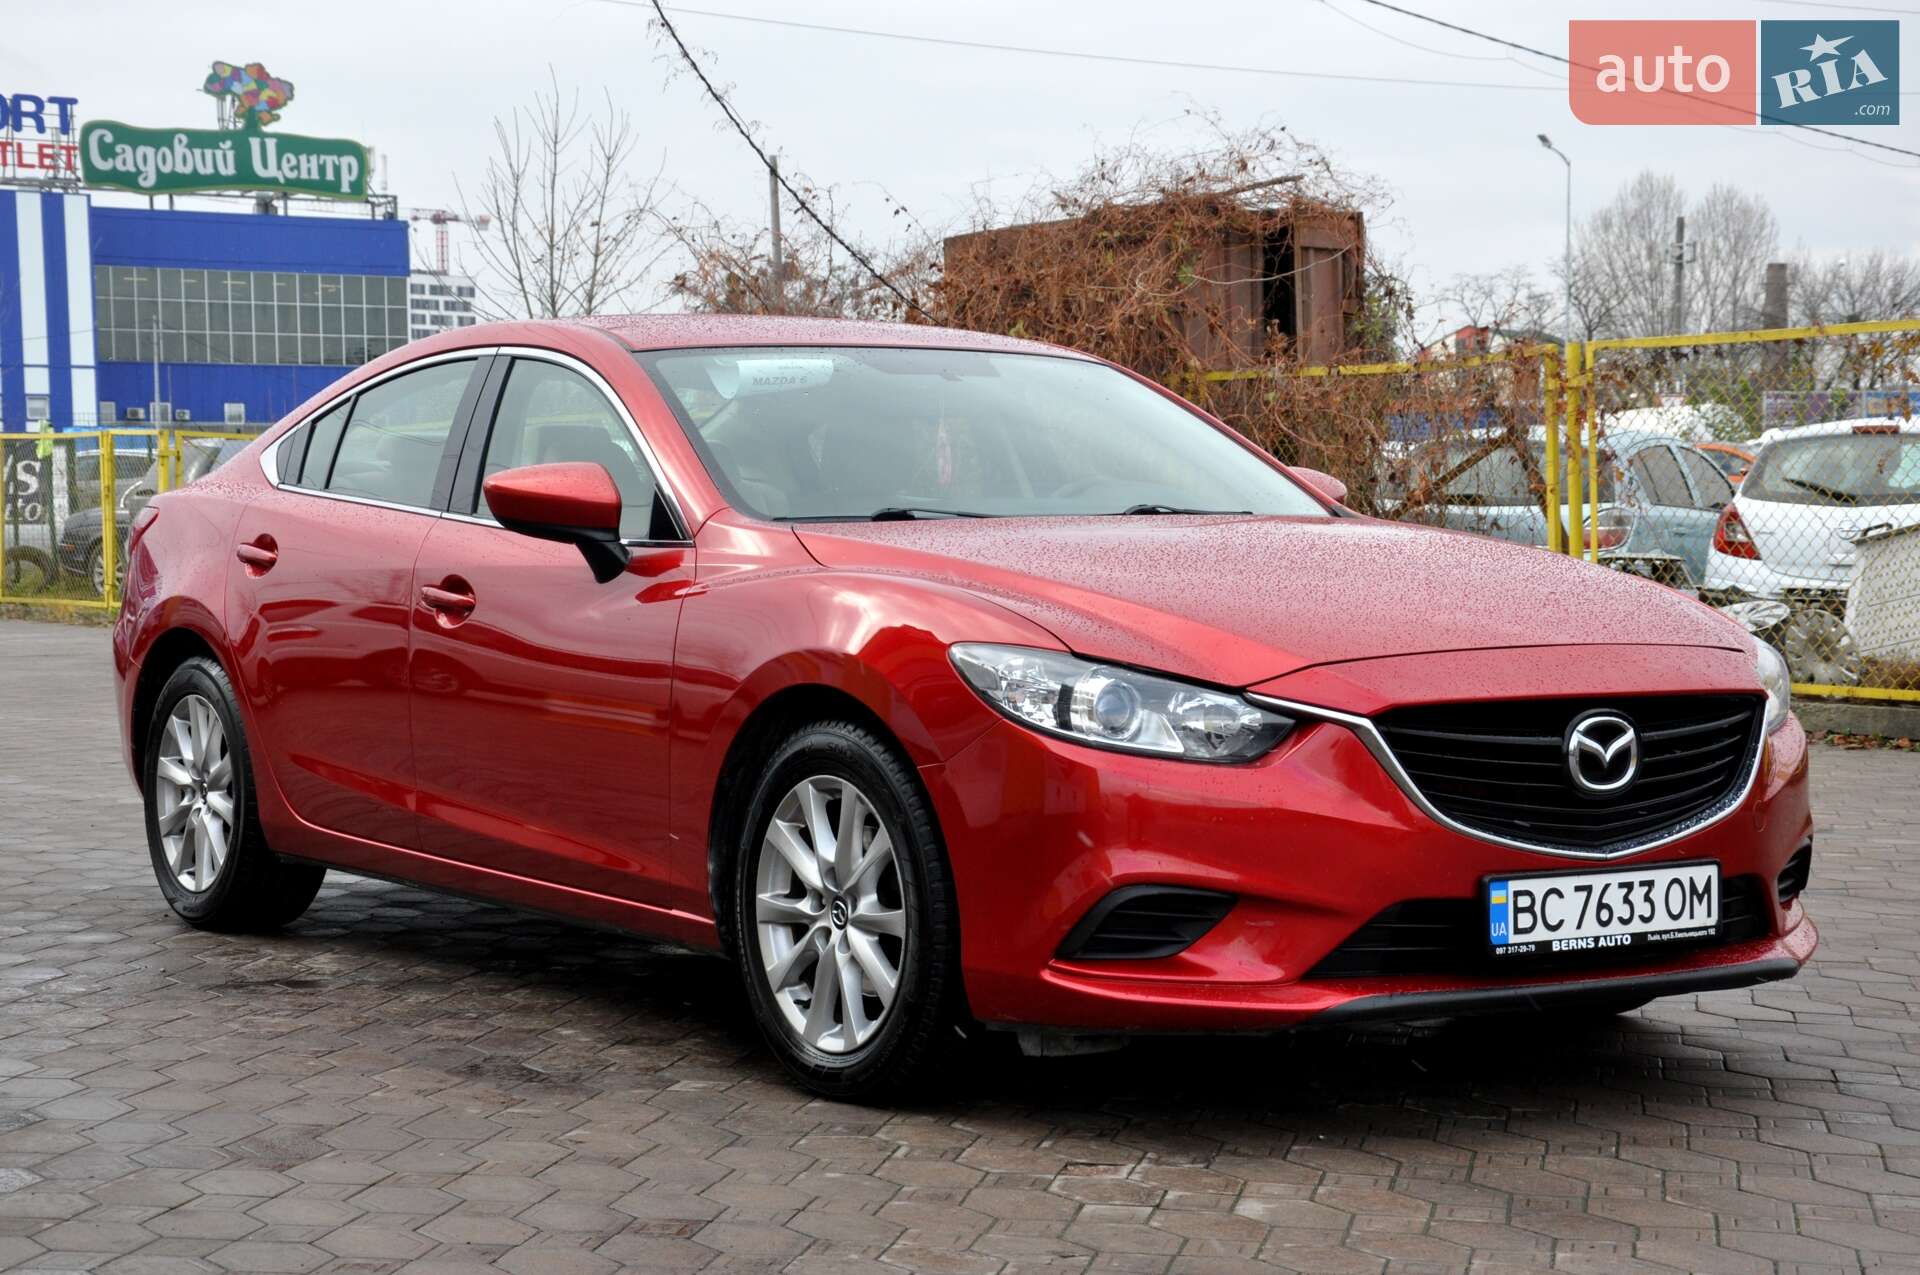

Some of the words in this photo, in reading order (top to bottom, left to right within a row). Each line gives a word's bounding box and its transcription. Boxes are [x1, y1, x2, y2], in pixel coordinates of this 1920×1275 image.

[88, 128, 237, 188] Садовий
[248, 136, 360, 194] Центр
[752, 376, 796, 386] MAZDA
[1512, 887, 1565, 936] BC
[1574, 879, 1656, 930] 7633
[1664, 874, 1712, 921] OM
[1491, 922, 1508, 937] UA
[1552, 937, 1595, 952] BERNS
[1598, 934, 1632, 948] AUTO
